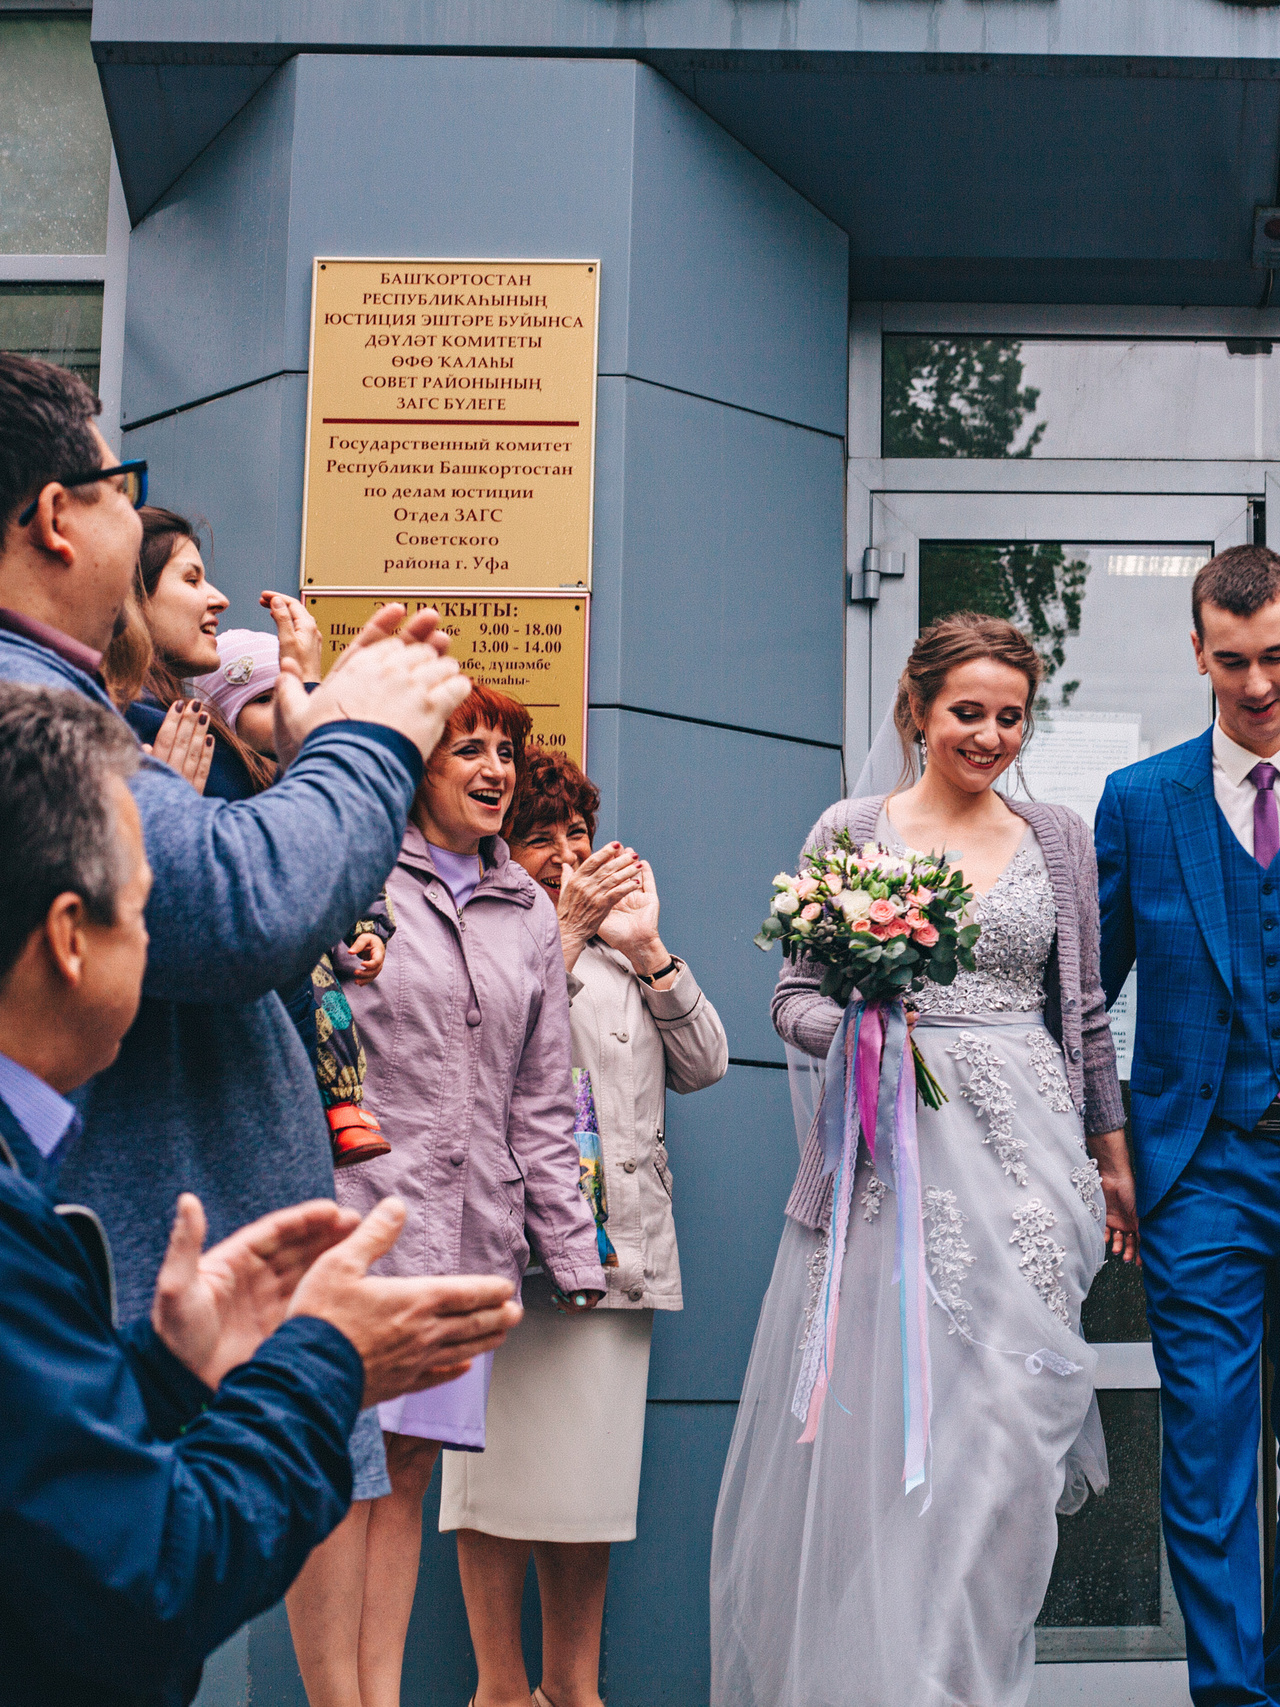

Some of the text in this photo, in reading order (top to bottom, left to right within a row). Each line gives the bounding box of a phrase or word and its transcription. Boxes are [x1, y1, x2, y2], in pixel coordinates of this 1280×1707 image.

[324, 312, 584, 328] ЮСТИЦИЯ ЭШТӘРЕ БУЙЫНСА
[441, 335, 543, 349] КОМИТЕТЫ
[361, 374, 543, 392] СОВЕТ РАЙОНЫНЫҢ
[396, 397, 440, 410] ЗАГС
[328, 435, 573, 454] Государственный комитет
[325, 459, 573, 479] Республики Башкортостан
[363, 487, 534, 500] по делам юстиции
[393, 507, 503, 523] Отдел ЗАГС
[395, 531, 500, 547] Советского
[383, 556, 510, 574] района г. Уфа
[479, 622, 510, 636] 9.00
[525, 623, 562, 636] 18.00
[472, 640, 509, 653] 13.00
[525, 641, 562, 653] 14.00
